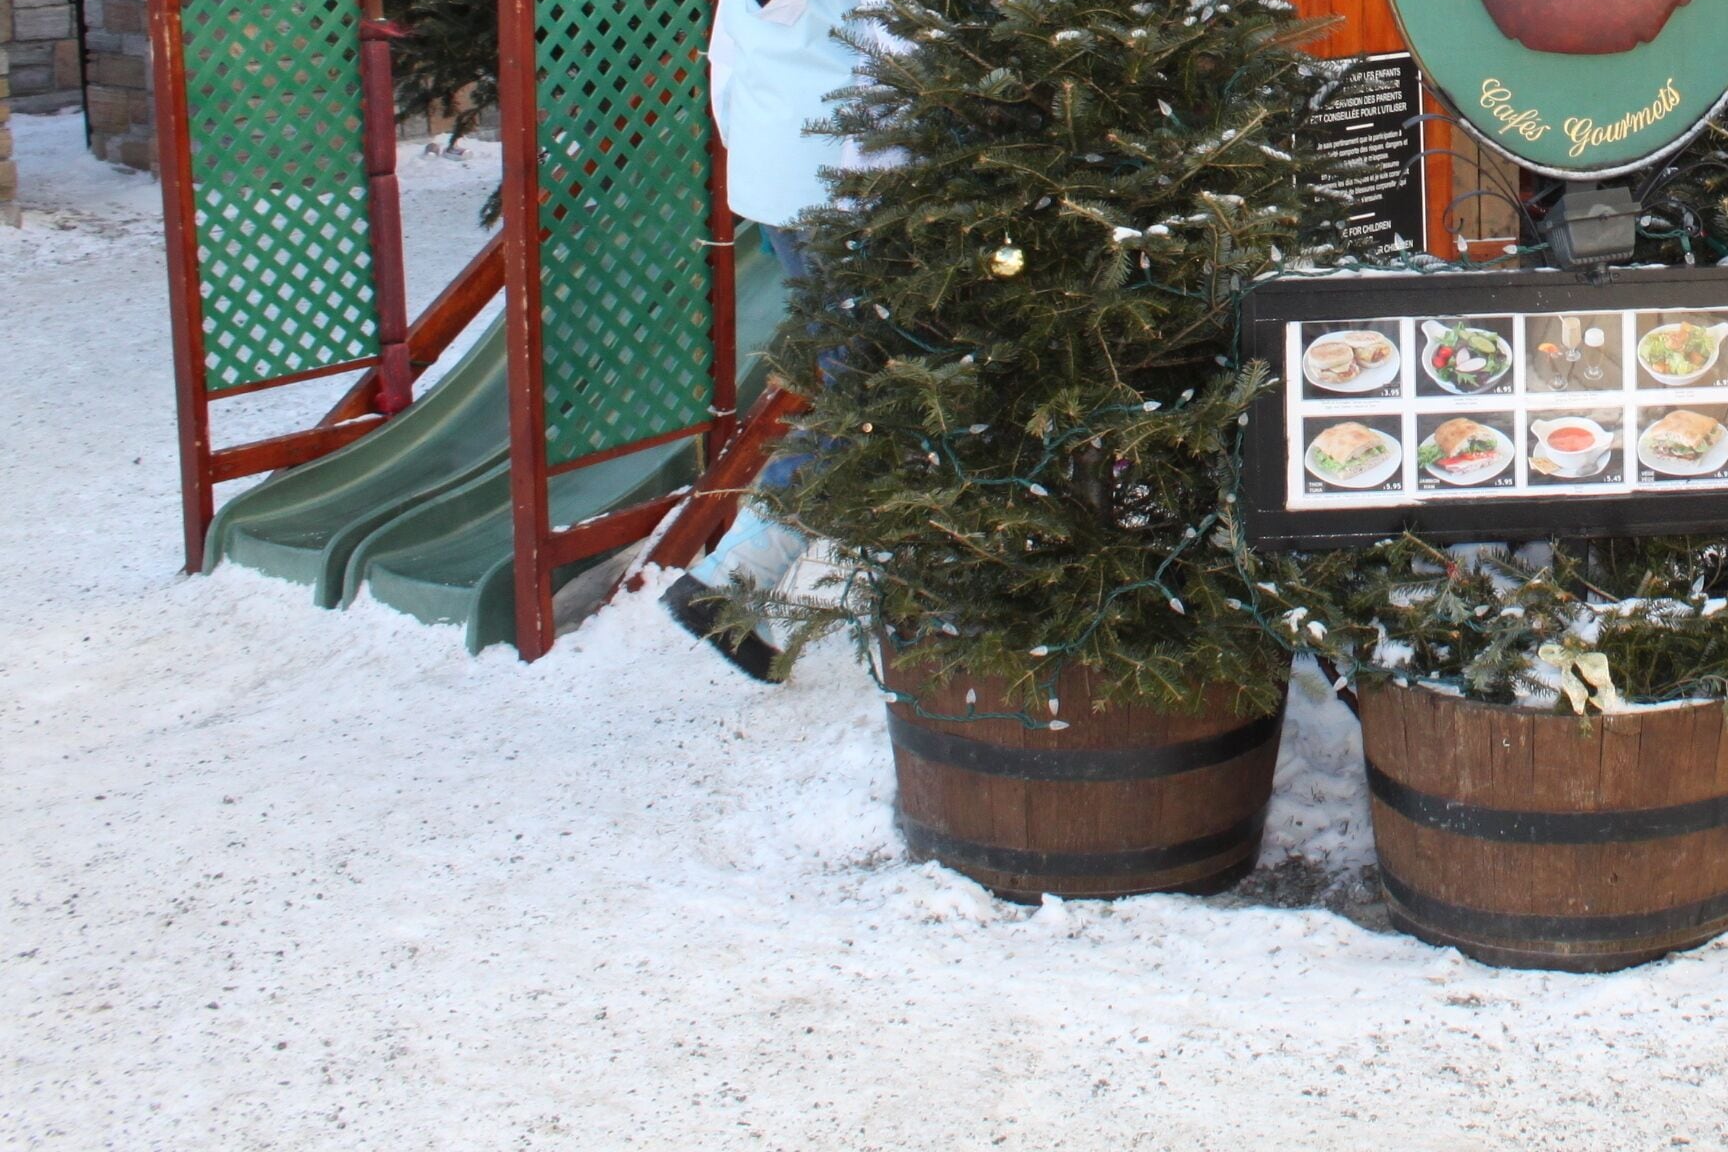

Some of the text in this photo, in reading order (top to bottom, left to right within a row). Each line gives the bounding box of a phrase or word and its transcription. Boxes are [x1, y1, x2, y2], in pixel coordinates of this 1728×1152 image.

[1375, 67, 1401, 80] ENFANTS
[1363, 94, 1376, 104] DES
[1376, 91, 1402, 103] PARENTS
[1360, 106, 1378, 117] POUR
[1479, 77, 1681, 158] Cafés Gourmets
[1349, 225, 1362, 236] FOR
[1362, 219, 1392, 234] CHILDREN
